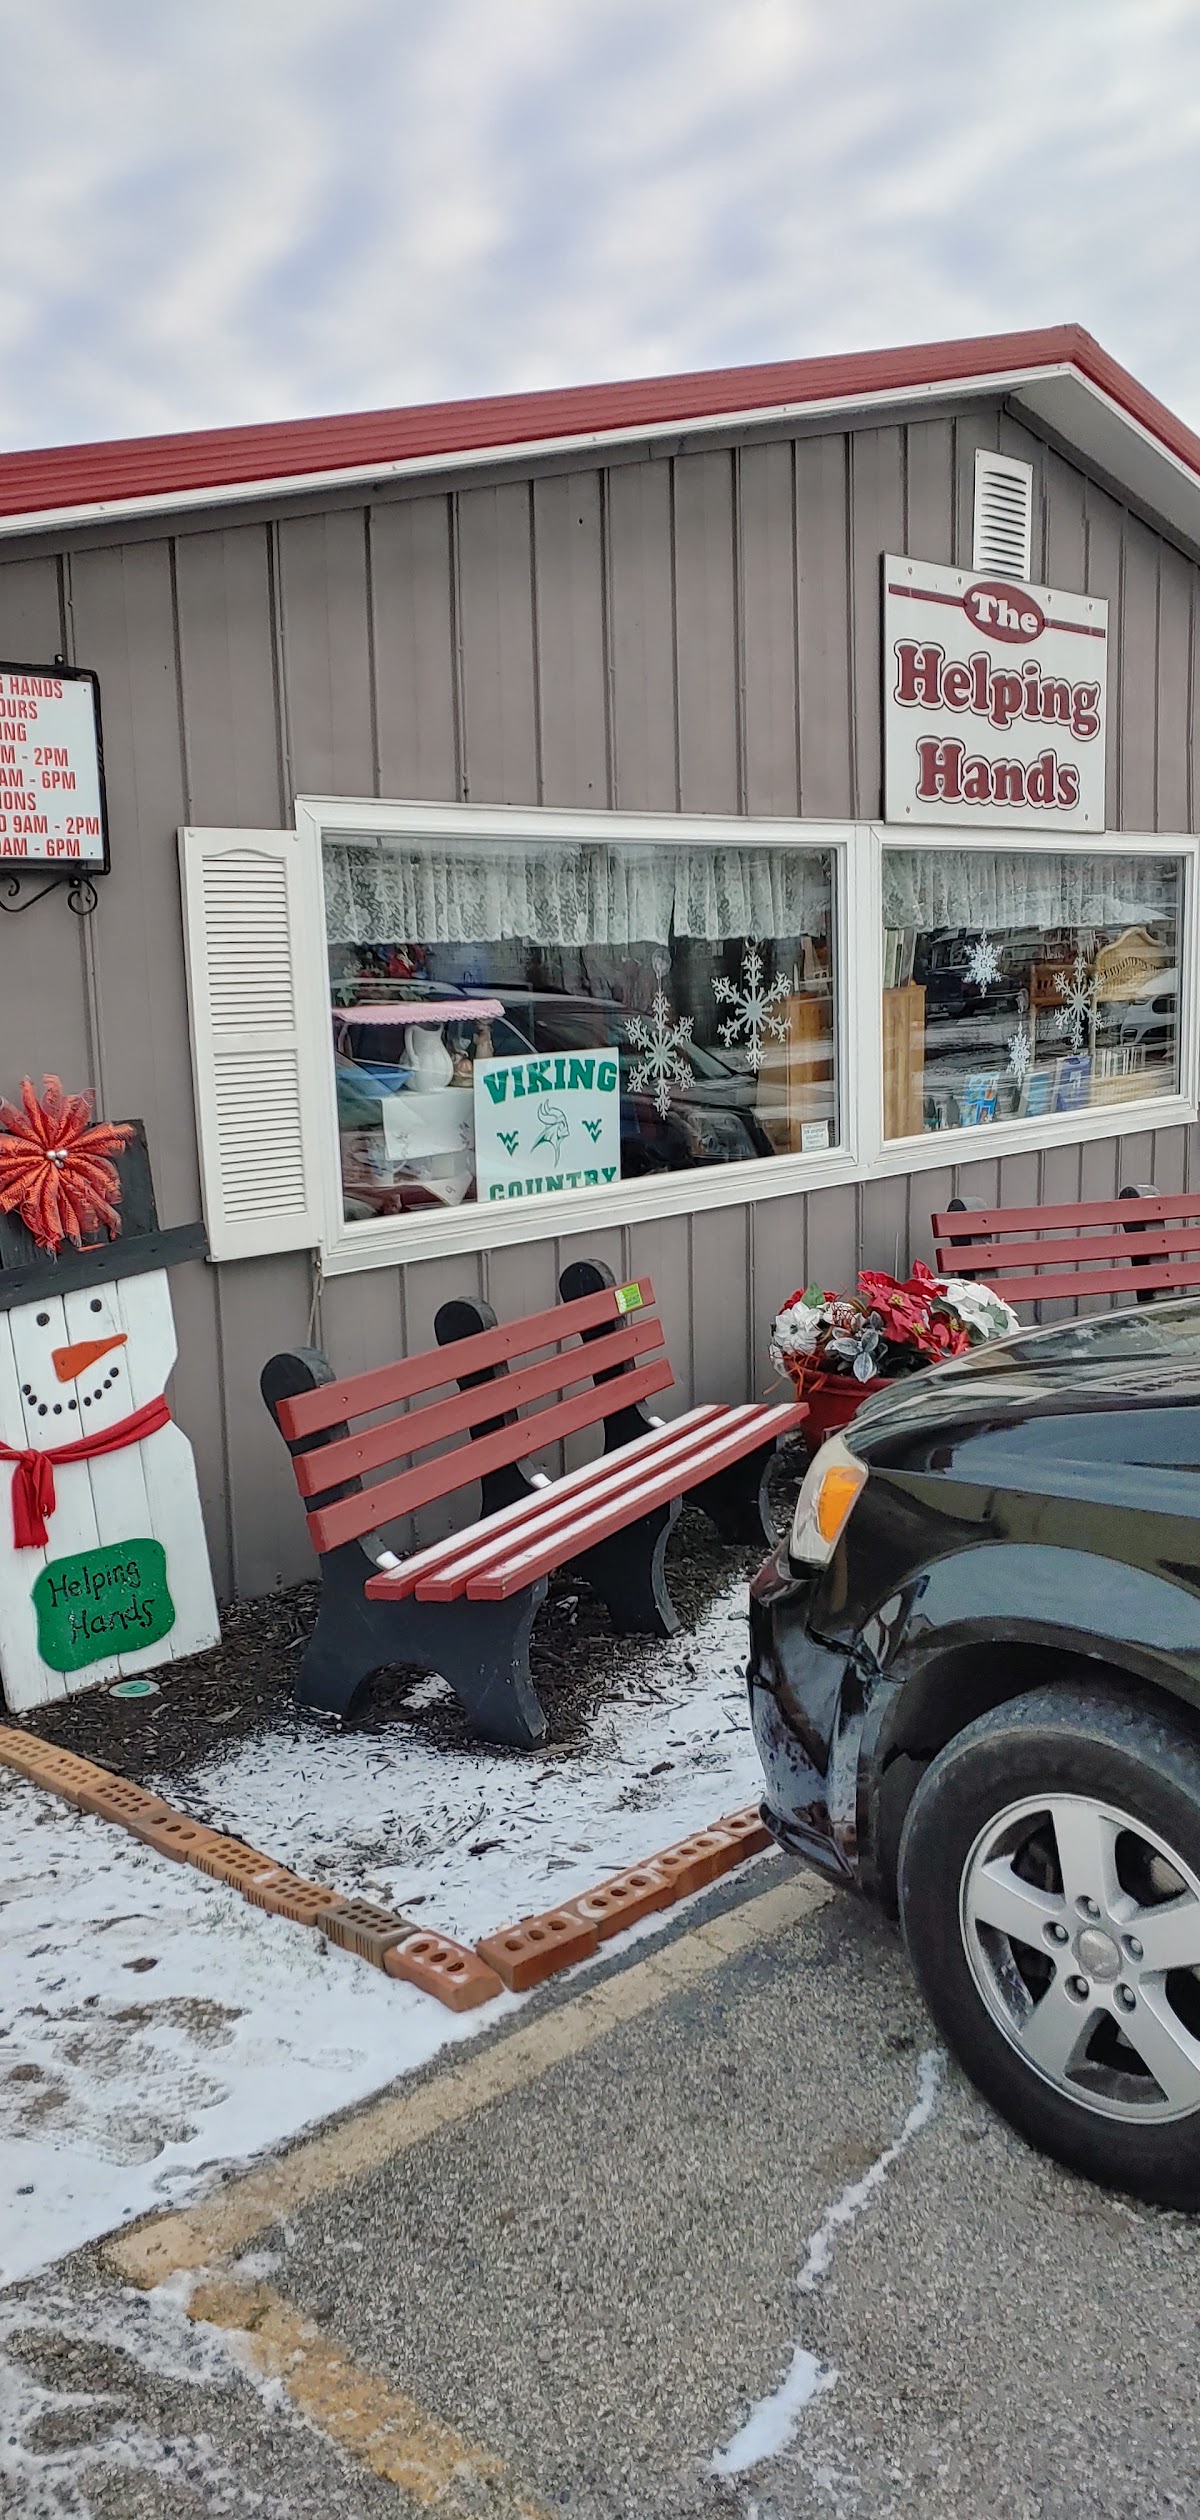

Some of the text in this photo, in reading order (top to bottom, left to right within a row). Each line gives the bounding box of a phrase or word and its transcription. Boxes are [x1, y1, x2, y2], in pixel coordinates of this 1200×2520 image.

[971, 591, 1039, 634] The
[10, 676, 63, 699] HANDS
[894, 639, 1100, 742] Helping
[34, 747, 69, 767] 2PM
[916, 735, 1079, 810] Hands
[41, 770, 76, 790] 6PM
[13, 815, 48, 834] 9AM
[65, 816, 100, 835] 2PM
[46, 838, 81, 857] 6PM
[483, 1058, 618, 1105] VIKING
[47, 1561, 141, 1608] Helping
[68, 1594, 156, 1645] Hands
